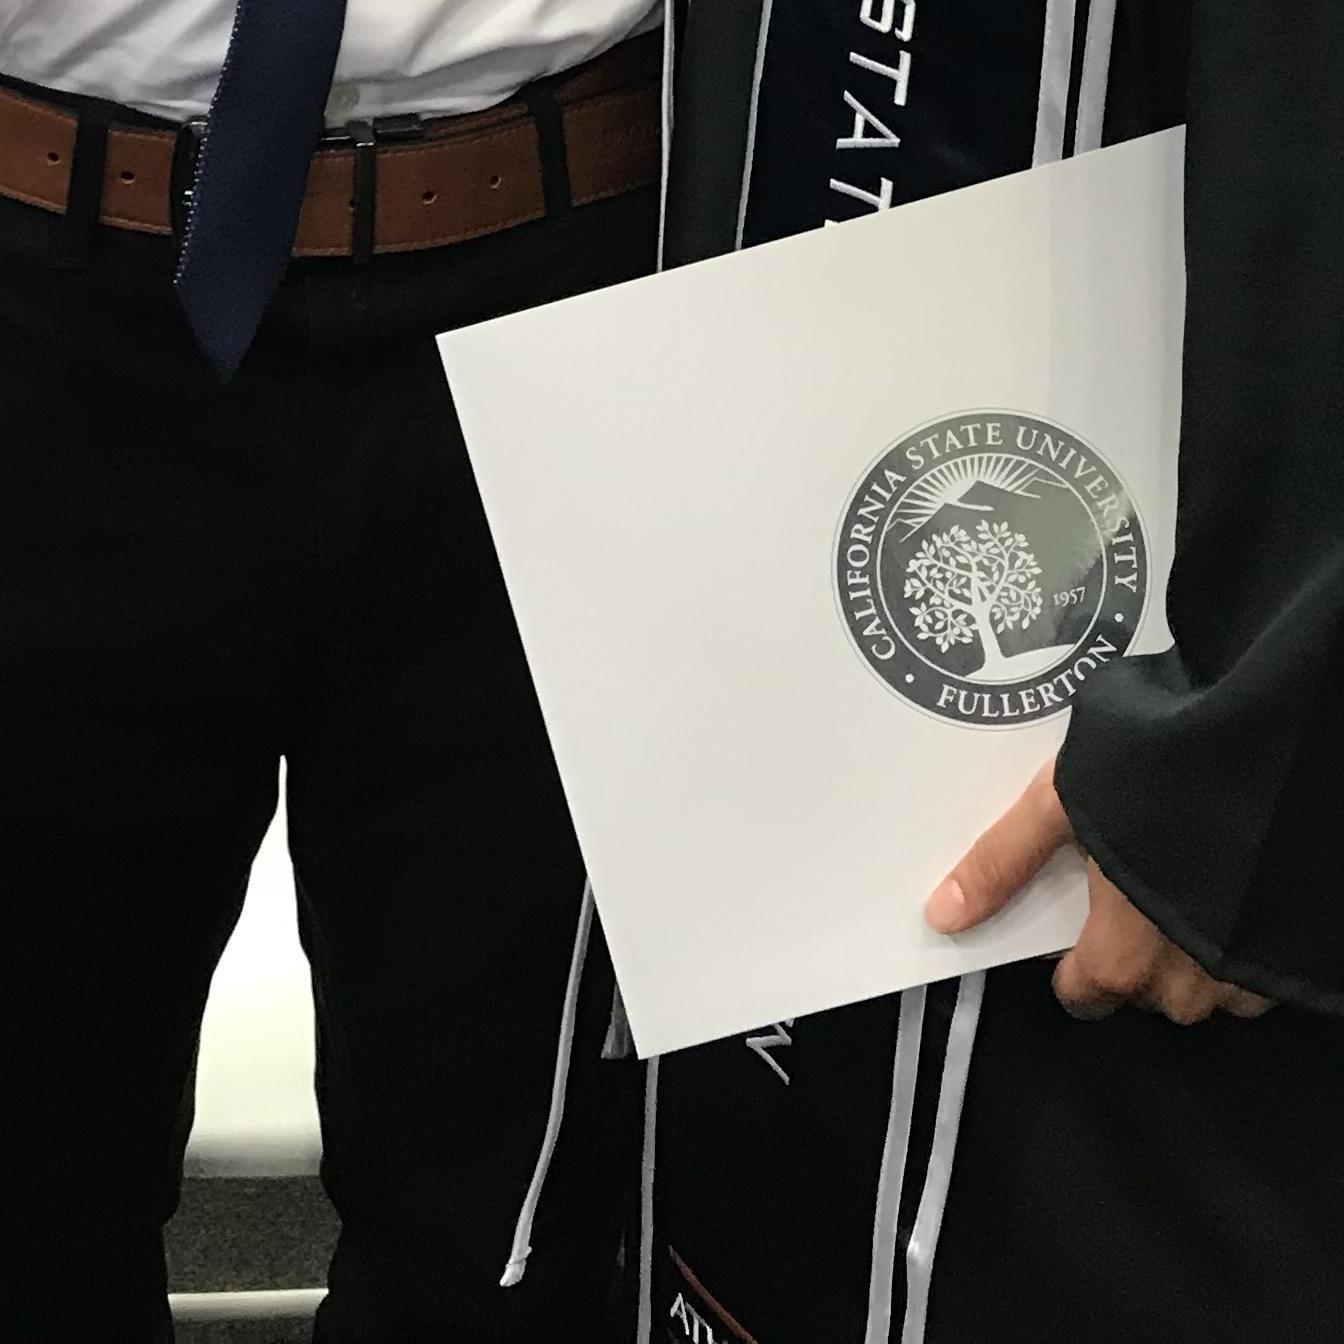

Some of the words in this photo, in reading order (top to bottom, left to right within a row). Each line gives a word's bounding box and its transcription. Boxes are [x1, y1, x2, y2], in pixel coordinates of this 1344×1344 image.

[845, 467, 908, 662] CALIFORNIA
[905, 422, 1004, 471] STATE
[1015, 425, 1140, 594] UNIVERSITY
[1051, 585, 1088, 608] 1957
[935, 633, 1119, 718] FULLERTON
